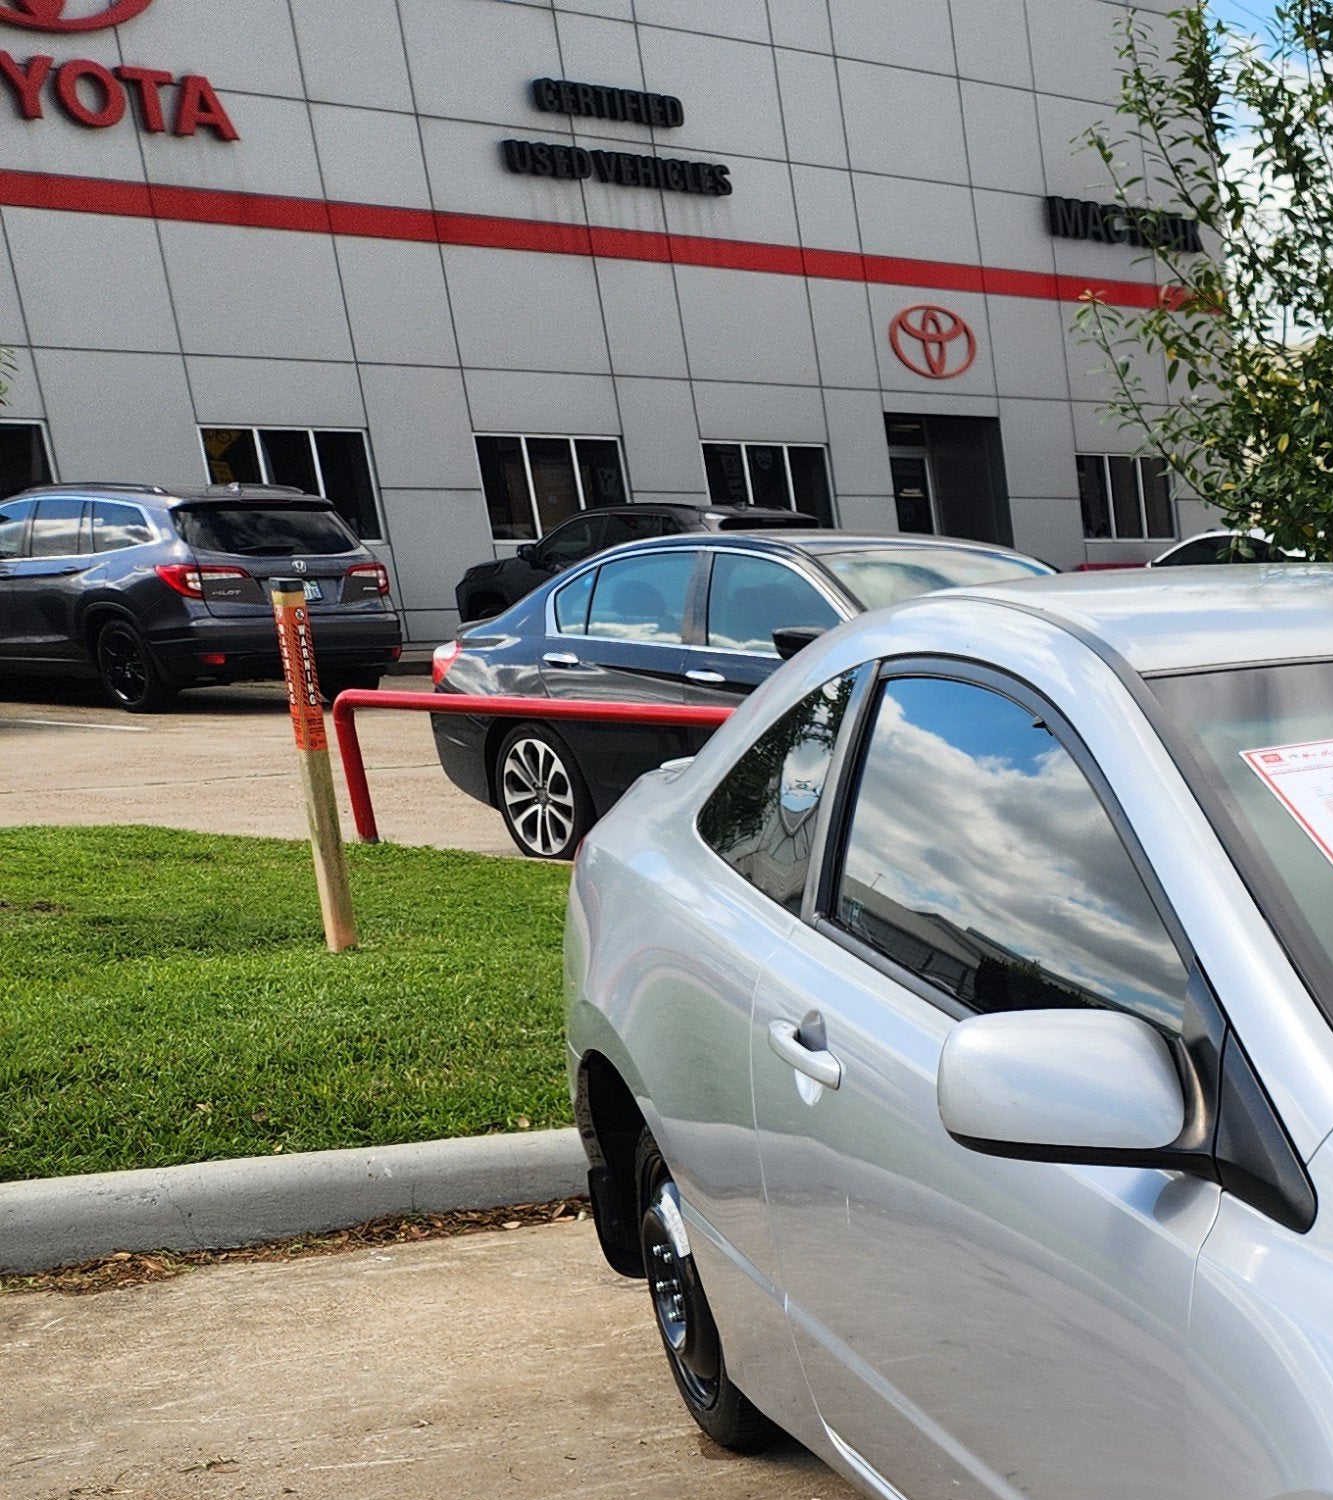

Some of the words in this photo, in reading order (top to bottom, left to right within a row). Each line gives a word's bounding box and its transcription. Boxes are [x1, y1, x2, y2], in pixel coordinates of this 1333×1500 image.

[532, 78, 683, 127] CERTIFIED
[501, 139, 592, 179] USED
[590, 150, 732, 196] VEHICLES
[1125, 207, 1204, 253] AIK
[297, 623, 317, 706] WARNING
